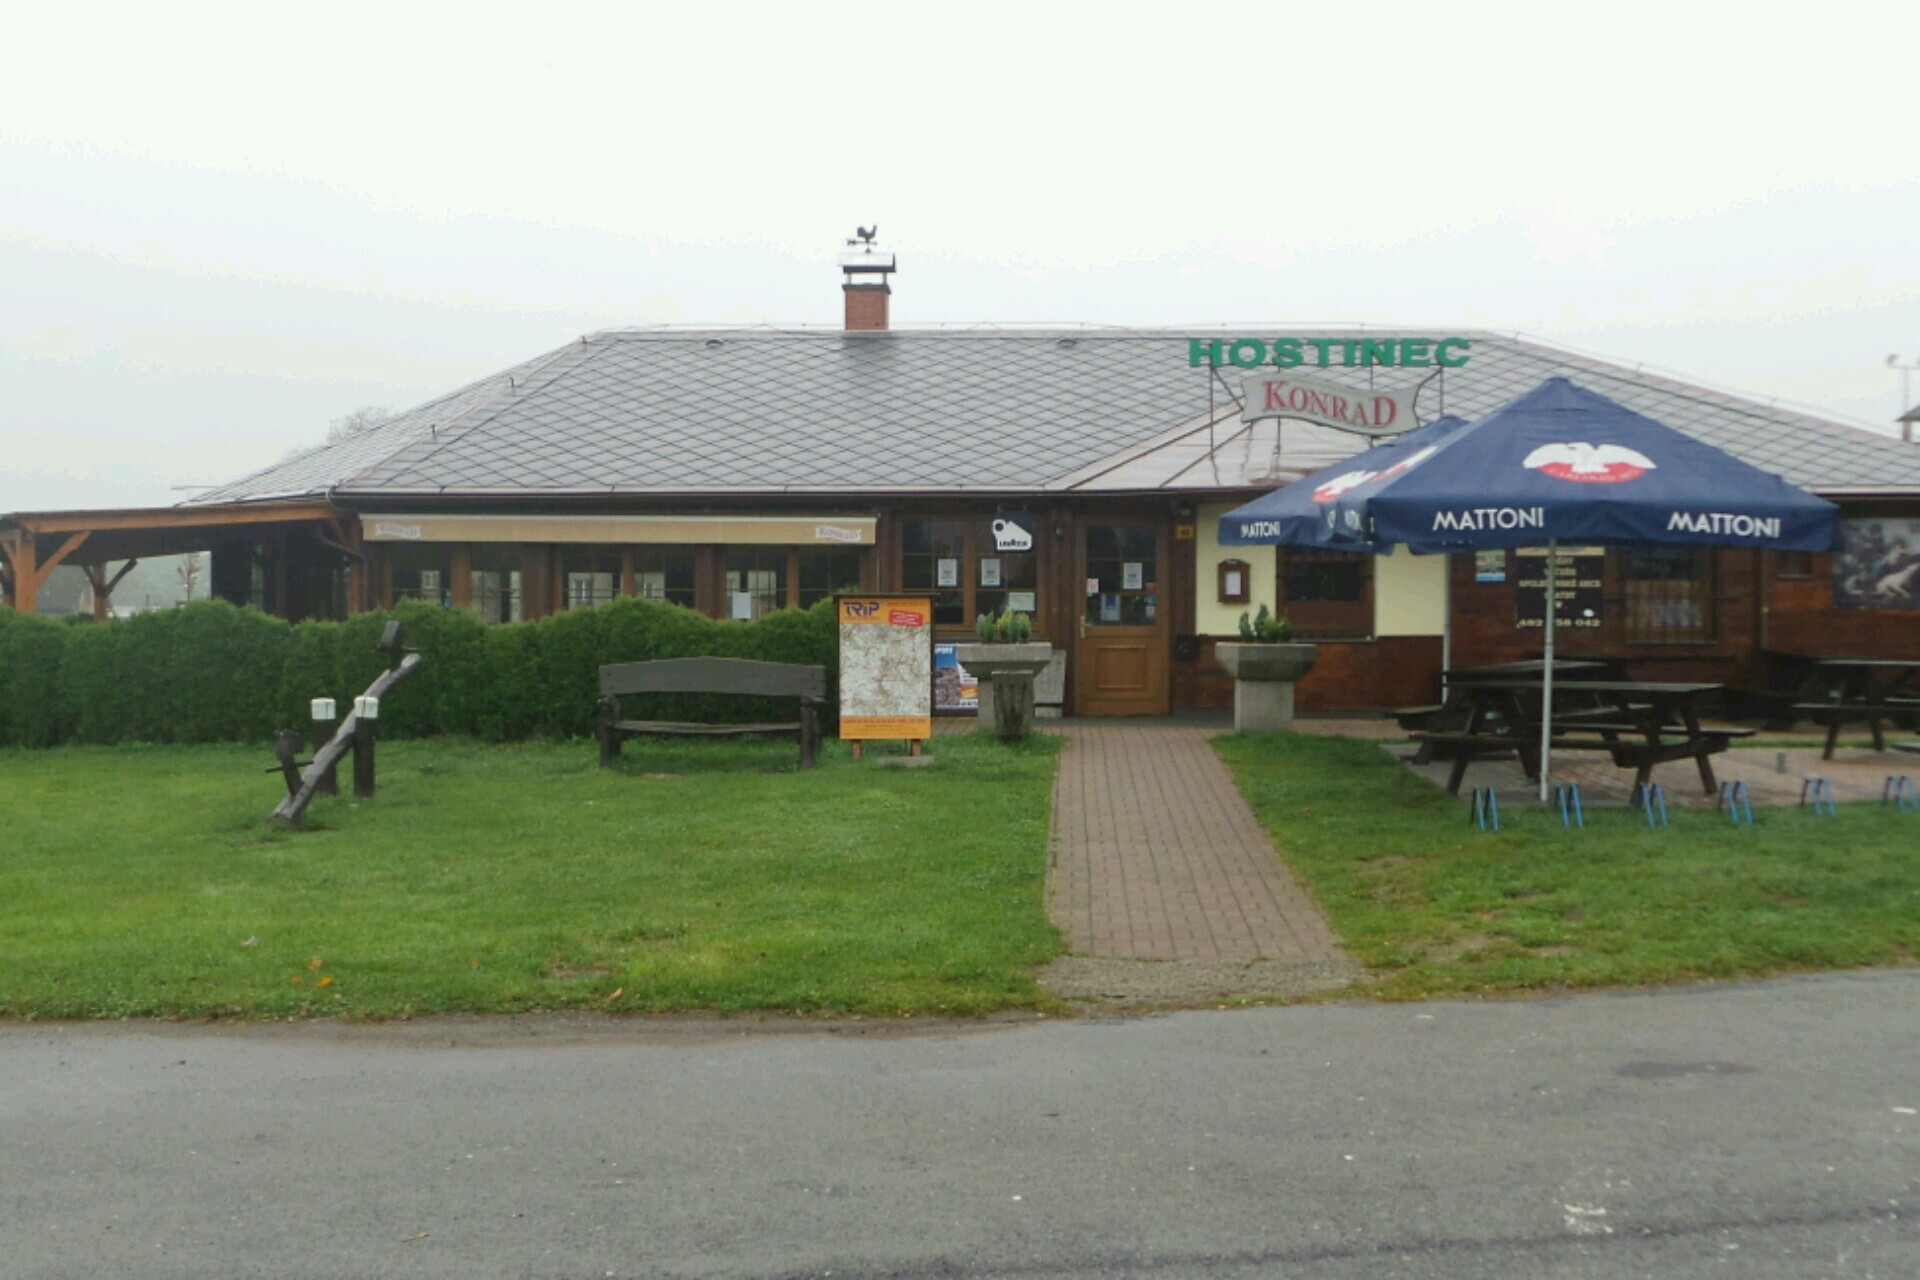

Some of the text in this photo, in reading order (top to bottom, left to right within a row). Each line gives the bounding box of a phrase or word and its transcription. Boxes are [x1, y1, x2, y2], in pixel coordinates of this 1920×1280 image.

[1189, 338, 1471, 368] HOSTINEC
[1262, 380, 1397, 428] KONRAD
[1240, 520, 1281, 538] MATTONI
[1433, 507, 1545, 531] MATTONI
[1667, 511, 1781, 538] MATTONI
